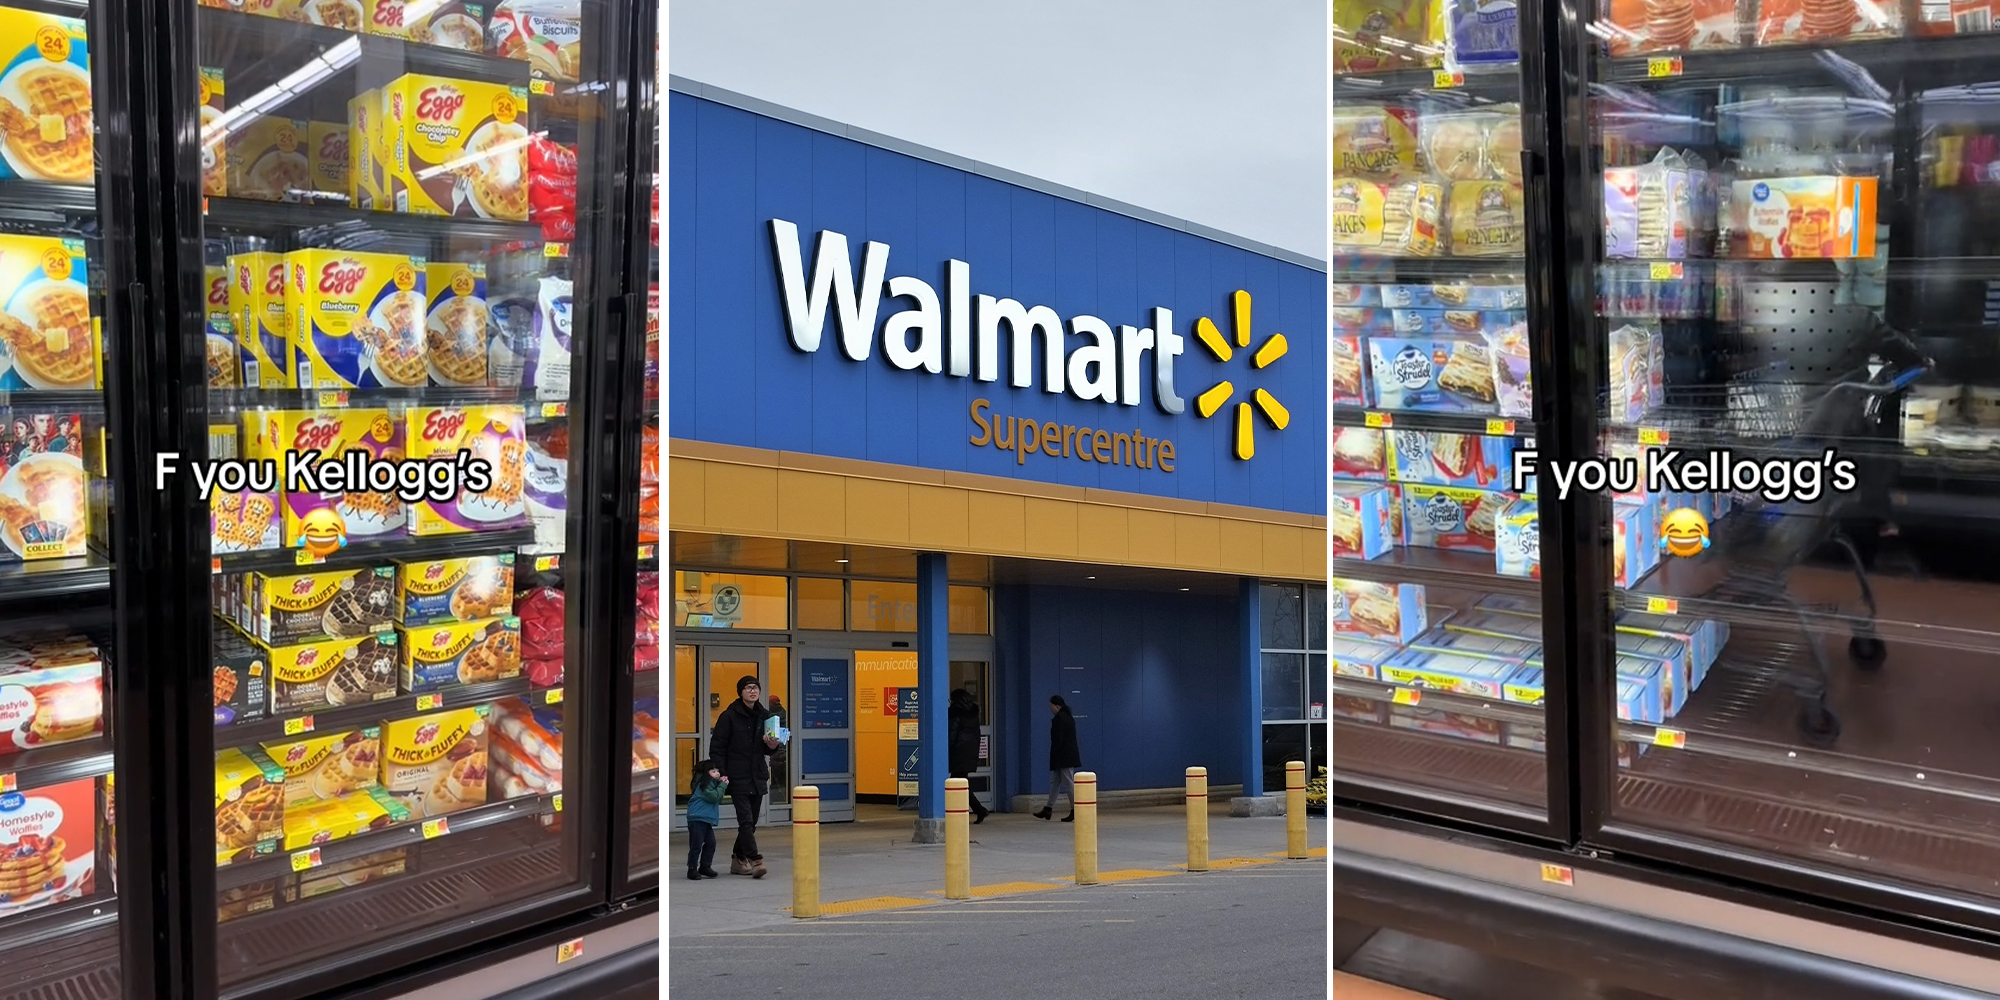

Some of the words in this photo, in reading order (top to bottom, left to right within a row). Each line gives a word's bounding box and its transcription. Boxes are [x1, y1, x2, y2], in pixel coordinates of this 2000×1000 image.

[542, 24, 579, 36] Biscuits
[43, 36, 63, 49] 24
[1650, 62, 1666, 76] 374
[416, 88, 465, 121] Eggo
[497, 102, 513, 114] 24
[280, 131, 293, 143] 24
[416, 123, 461, 137] Chocolatey
[428, 132, 447, 144] Chip
[1343, 152, 1399, 168] PANCAKES
[1333, 215, 1366, 233] AKES
[49, 257, 65, 269] 24
[318, 262, 367, 295] Eggo
[398, 270, 411, 282] 24
[456, 277, 469, 288] 24
[320, 301, 360, 313] Blueberry
[767, 218, 1184, 415] Walmart
[1396, 356, 1426, 370] Toaster
[1397, 366, 1431, 385] Strudel
[376, 422, 389, 433] 24
[422, 409, 467, 441] Eggo
[293, 418, 343, 450] Eggo
[969, 398, 1176, 473] Supercentre
[1428, 508, 1460, 525] Strudel
[1429, 503, 1455, 514] Toaster
[26, 543, 63, 553] COLLECT
[409, 579, 433, 592] THICK
[437, 567, 464, 590] FLUFFY
[424, 564, 446, 580] Eggo
[292, 578, 316, 595] Eggo
[274, 595, 302, 609] THICK
[307, 581, 338, 607] FLUFFY
[868, 594, 914, 622] Ente
[417, 647, 441, 659] THICK
[445, 632, 471, 657] FLUFFY
[432, 631, 452, 647] Eggo
[279, 666, 306, 679] THICK
[311, 651, 341, 677] FLUFFY
[295, 649, 319, 666] Eggo
[811, 675, 831, 683] Walmart
[393, 747, 424, 761] THICK
[430, 724, 465, 757] FLUFFY
[414, 725, 440, 745] Eggo
[286, 745, 308, 762] Eggo
[300, 745, 329, 771] FLUFFY
[397, 766, 430, 778] ORIGINAL
[9, 822, 43, 837] Waffles
